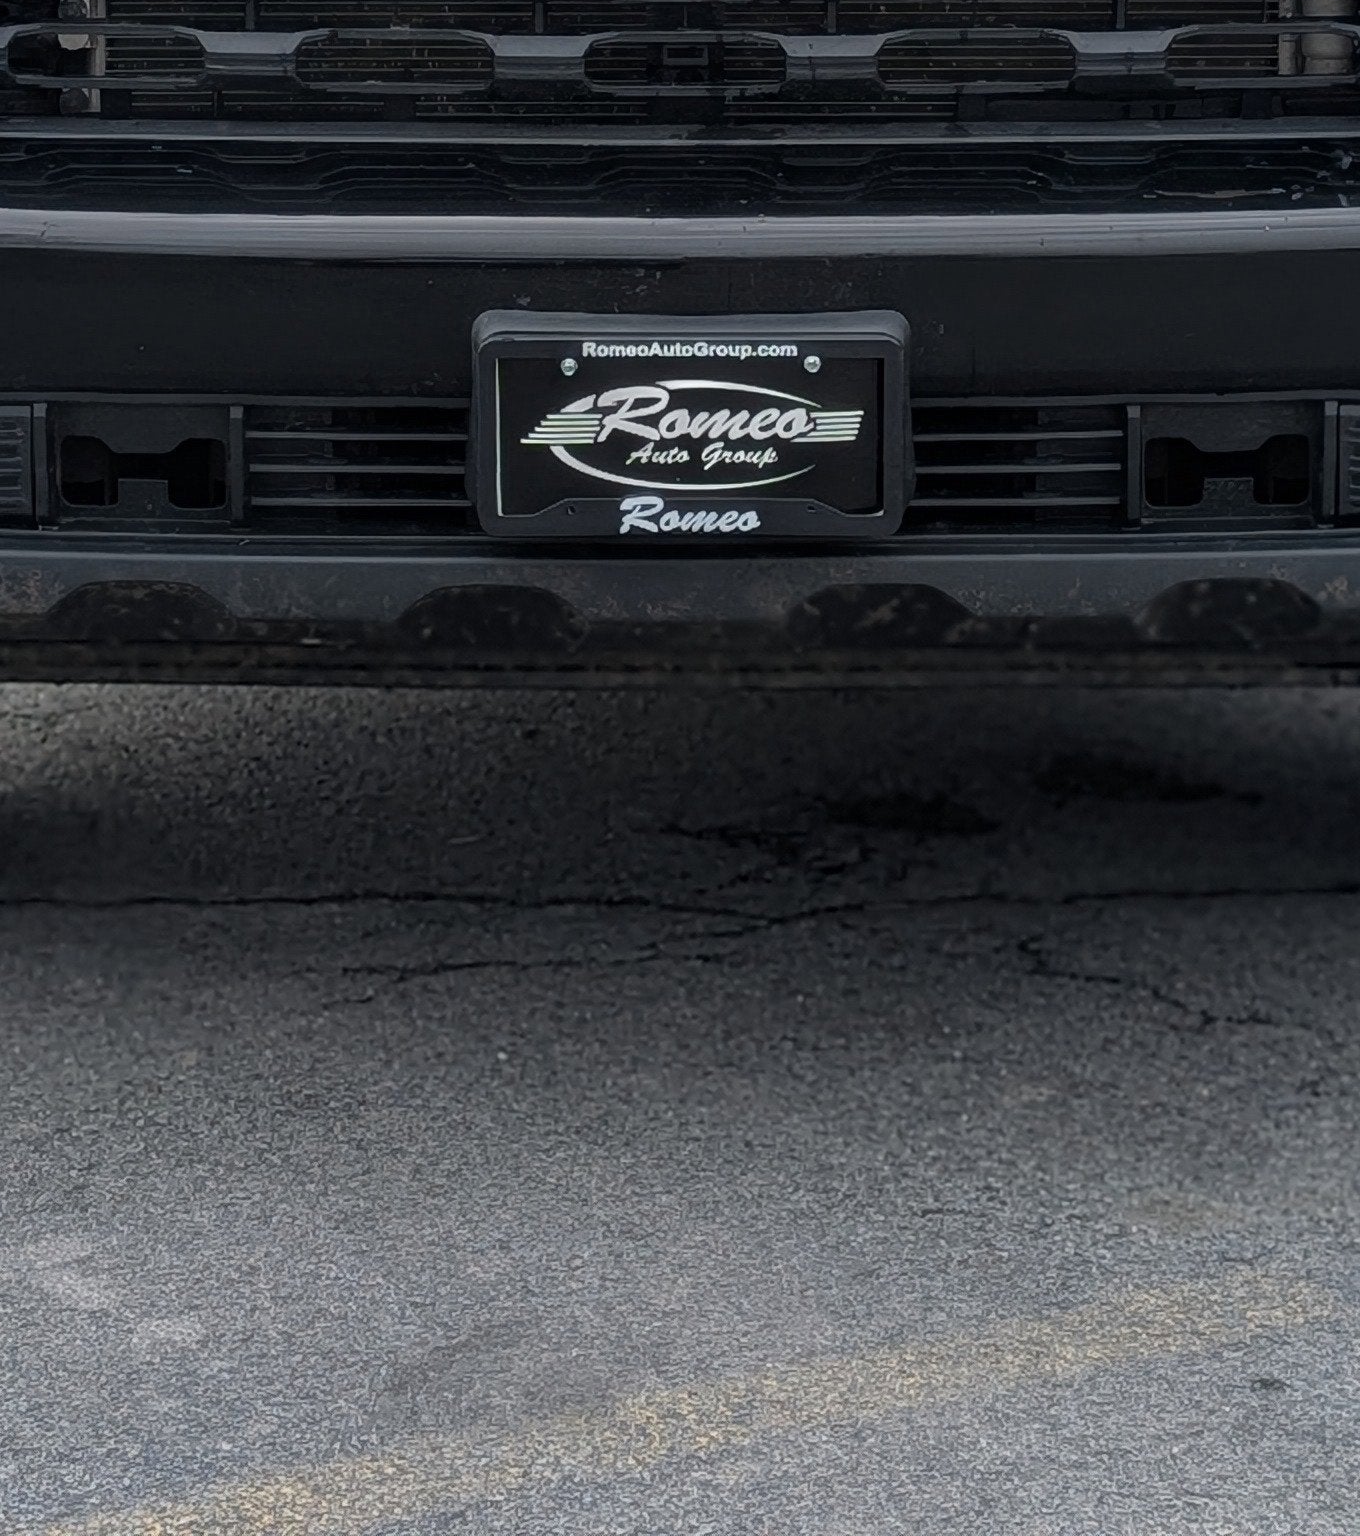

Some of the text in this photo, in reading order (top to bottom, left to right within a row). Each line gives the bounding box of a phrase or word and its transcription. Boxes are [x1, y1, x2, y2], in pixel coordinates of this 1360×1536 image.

[582, 341, 798, 360] RomeoAutoGroup.com
[596, 385, 815, 443] Romeo
[625, 441, 779, 471] Auto Group
[619, 495, 761, 534] Romeo
